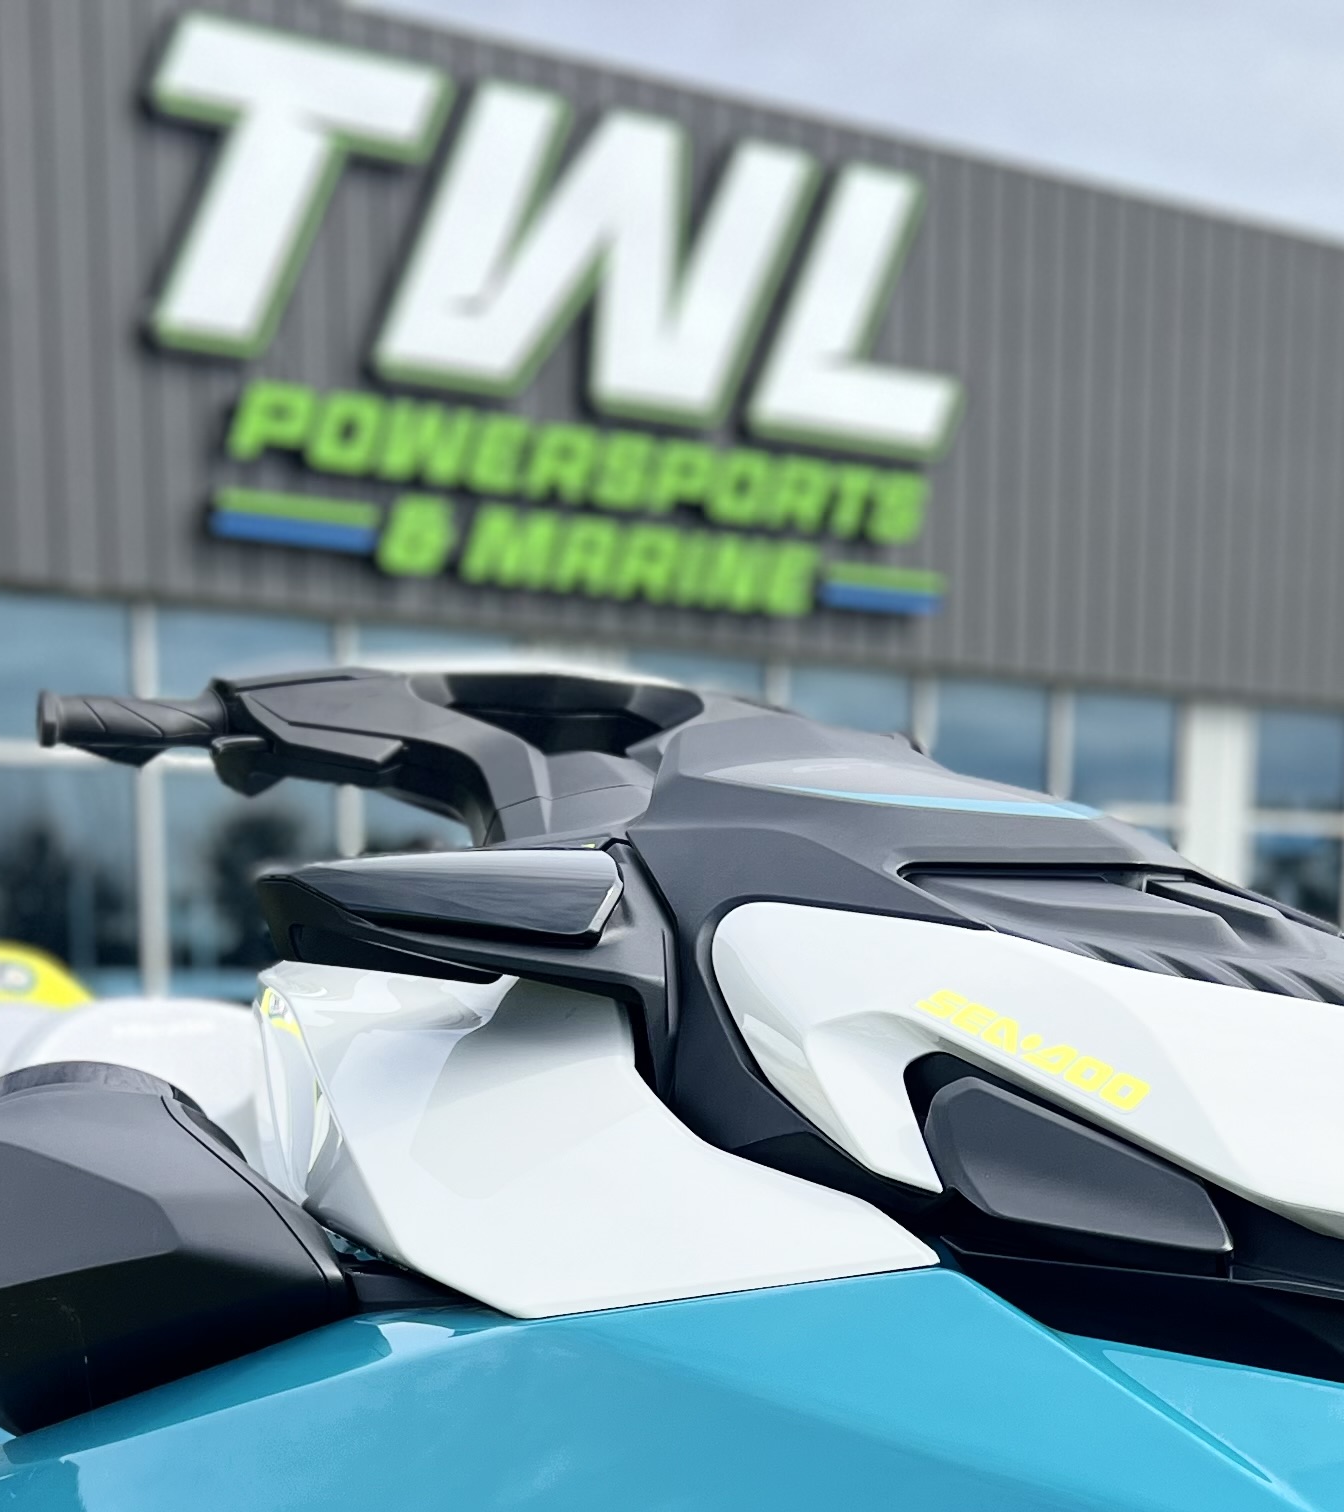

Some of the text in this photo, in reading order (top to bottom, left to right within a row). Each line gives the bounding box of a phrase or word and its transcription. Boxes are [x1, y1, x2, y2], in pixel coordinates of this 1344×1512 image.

[151, 12, 960, 458] TWL
[228, 380, 929, 545] POWERSPORTS
[376, 492, 822, 617] & MARINE
